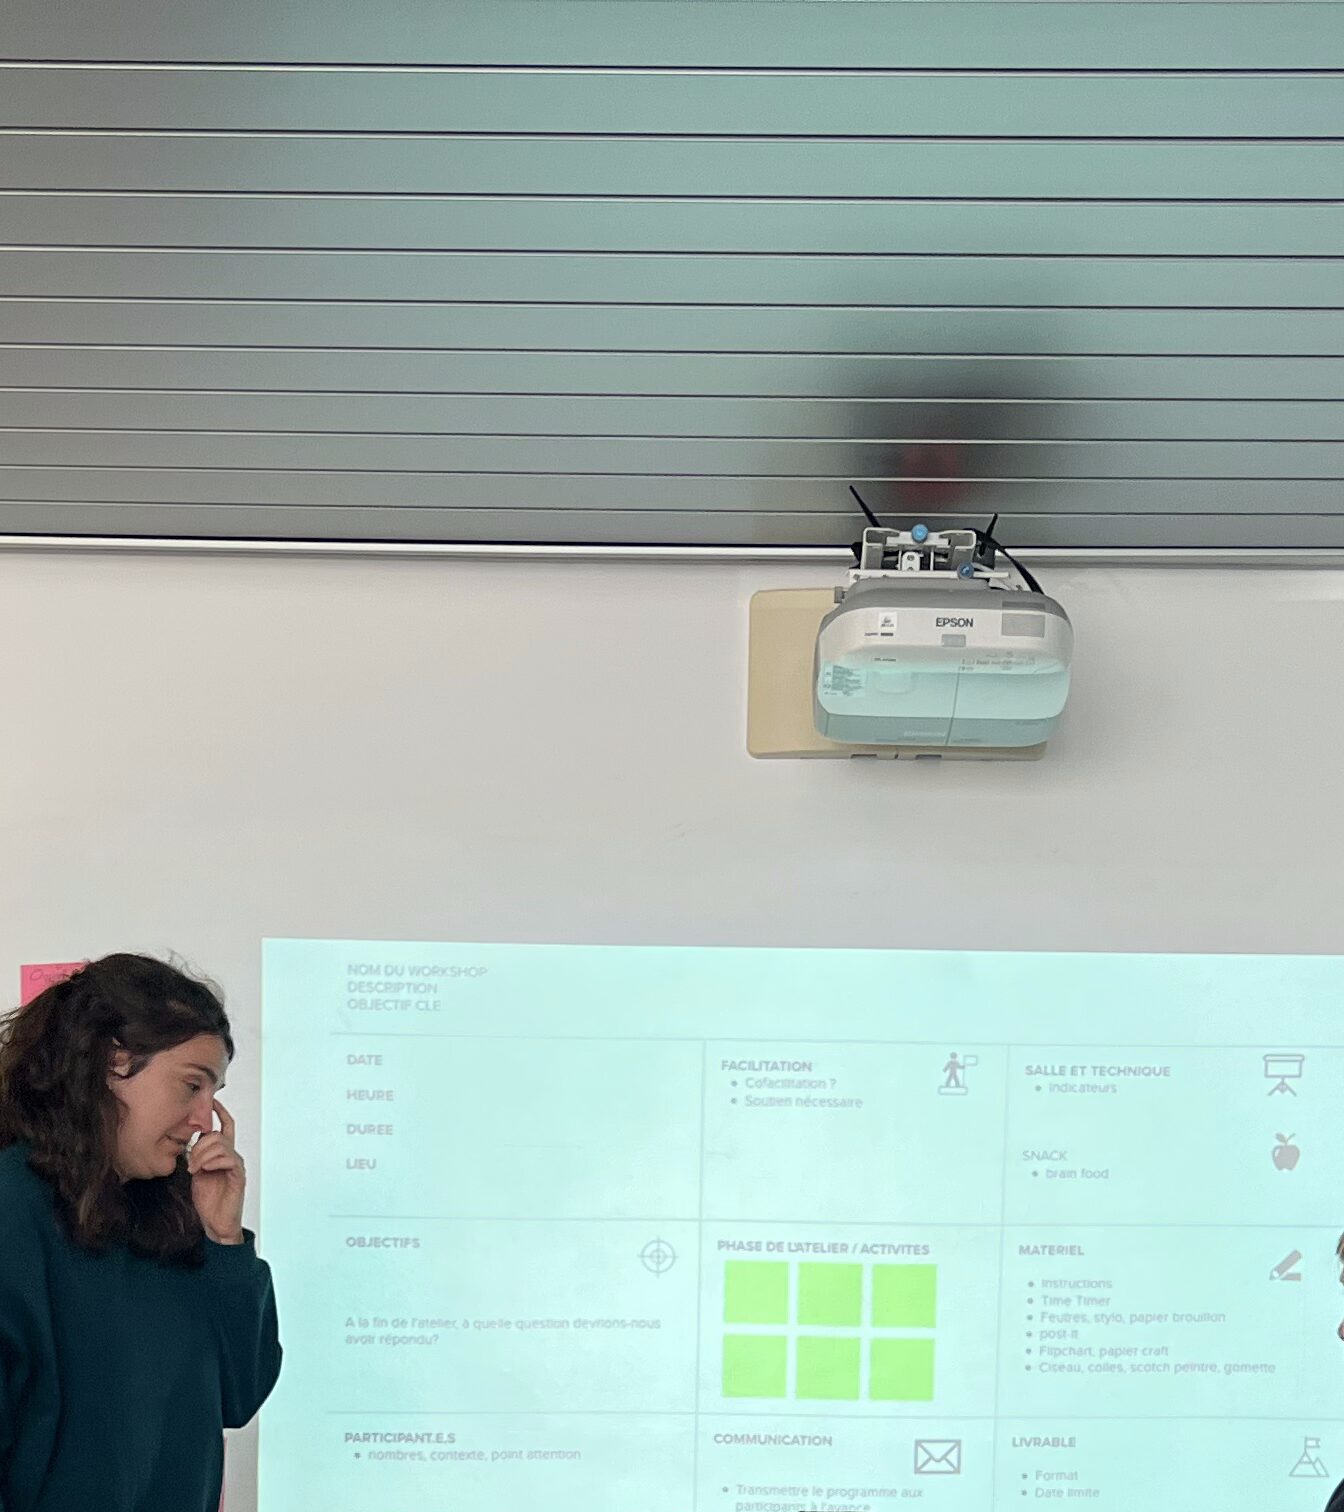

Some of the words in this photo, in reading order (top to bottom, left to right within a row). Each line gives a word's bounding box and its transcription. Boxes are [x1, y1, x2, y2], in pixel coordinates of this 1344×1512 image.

[935, 617, 975, 628] EPSON
[346, 964, 382, 978] NOM
[383, 964, 406, 978] DU
[408, 964, 489, 979] WORKSHOP
[346, 980, 439, 995] DESCRIPTION
[346, 998, 412, 1012] OBJECTIF
[346, 1053, 384, 1067] DATE
[720, 1059, 813, 1073] FACILITATION
[1024, 1064, 1067, 1077] SALLE
[1069, 1065, 1087, 1077] ET
[1090, 1065, 1172, 1079] TECHNIQUE
[346, 1088, 395, 1102] HEURE
[1022, 1149, 1068, 1162] SNACK
[346, 1157, 378, 1171] LIEU
[1079, 1166, 1110, 1180] food
[344, 1236, 422, 1250] OBJECTIFS
[716, 1239, 763, 1253] PHASE
[765, 1241, 785, 1254] DE
[1017, 1244, 1086, 1257] MATERIEL
[712, 1432, 834, 1447] COMMUNICATION
[1011, 1436, 1078, 1449] LIVRABLE
[1034, 1469, 1079, 1482] Format
[825, 1485, 899, 1501] programme
[1033, 1486, 1065, 1499] Date
